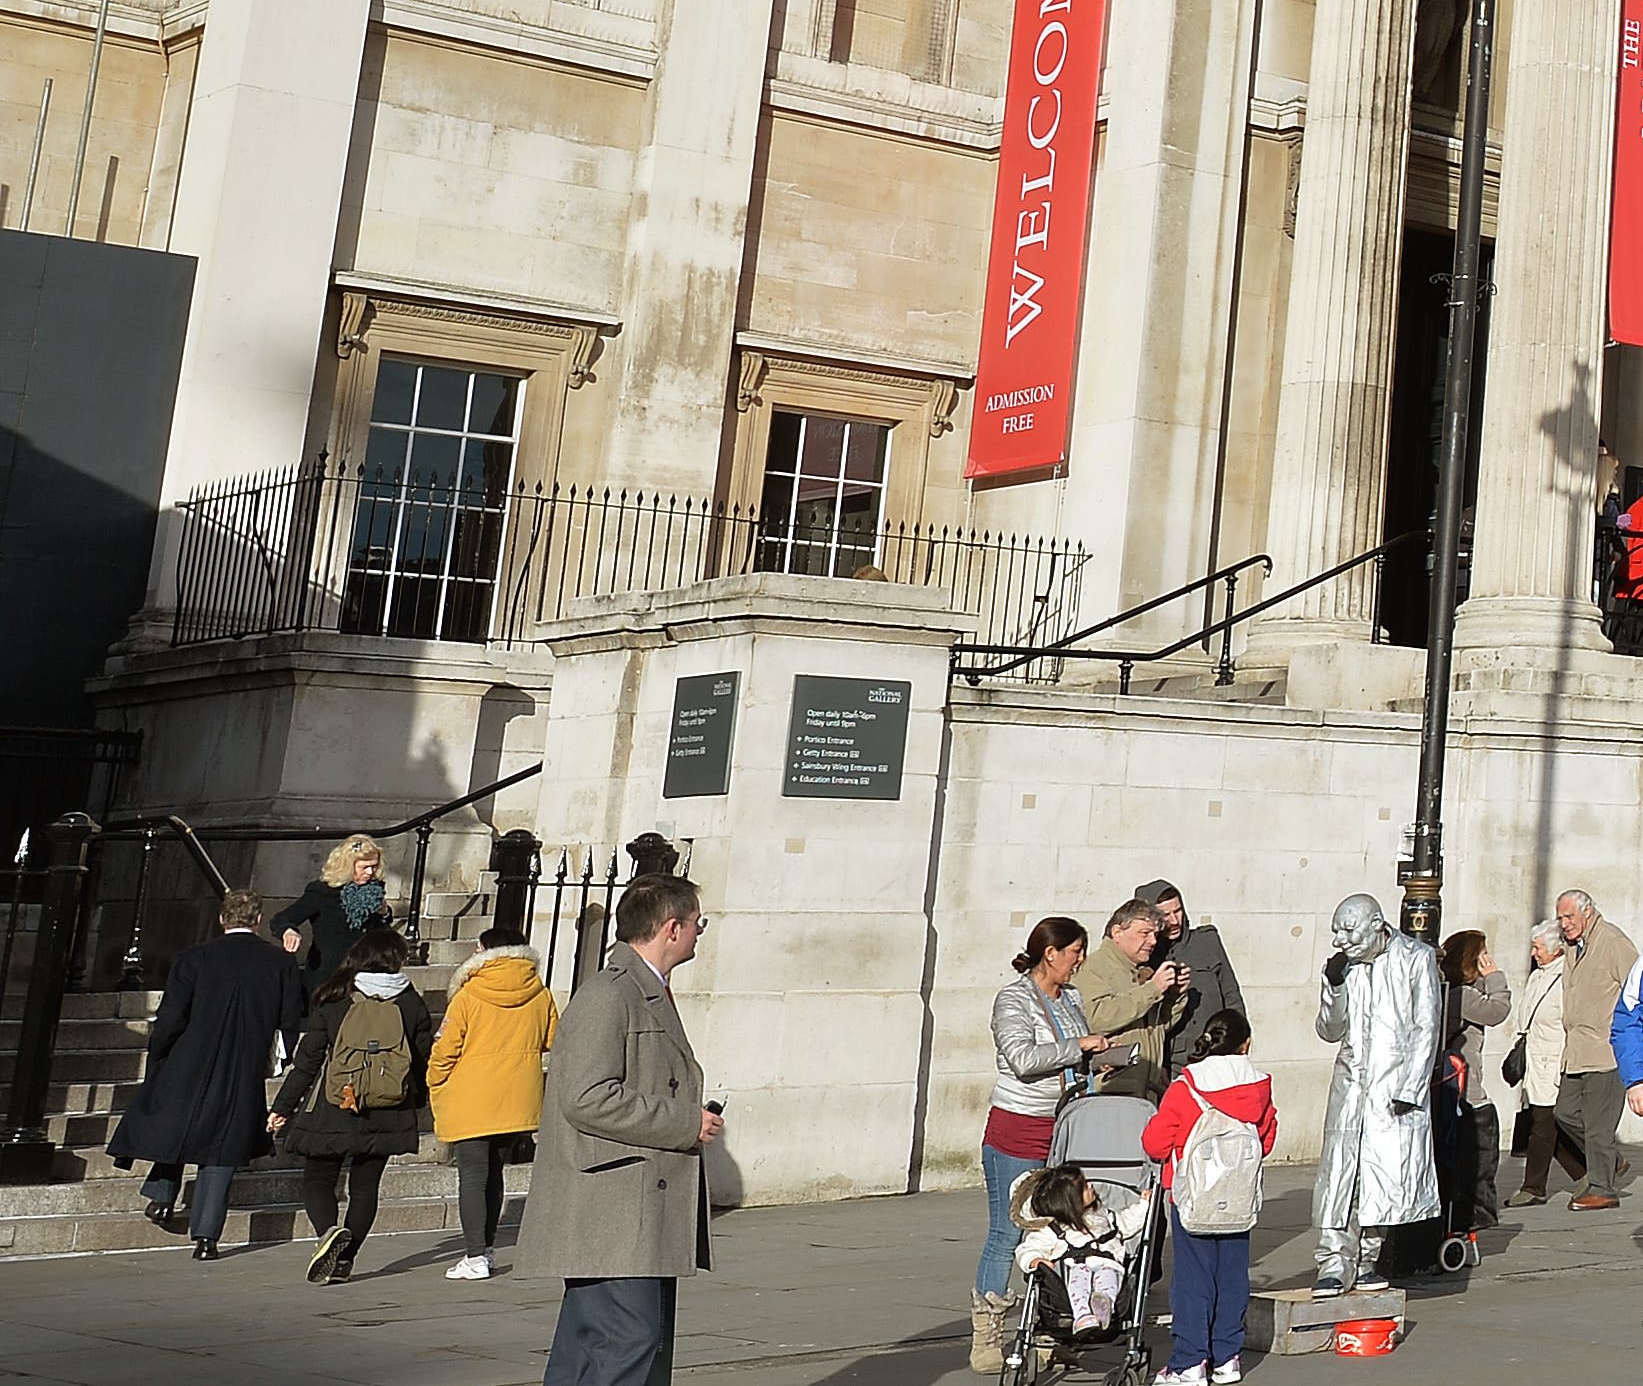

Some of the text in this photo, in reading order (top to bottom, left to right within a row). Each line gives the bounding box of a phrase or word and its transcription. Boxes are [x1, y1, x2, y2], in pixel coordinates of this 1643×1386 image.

[1622, 18, 1640, 69] THE
[984, 383, 1055, 413] ADMISSION
[1002, 413, 1034, 434] FREE
[806, 709, 825, 718] Open
[825, 710, 841, 719] daily
[806, 718, 825, 727] Friday
[804, 735, 855, 745] Portico Entrance
[802, 748, 849, 758] Getty Entrance
[800, 761, 877, 772] Sainsbury Wing Entrance
[800, 774, 859, 785] Education Entrance
